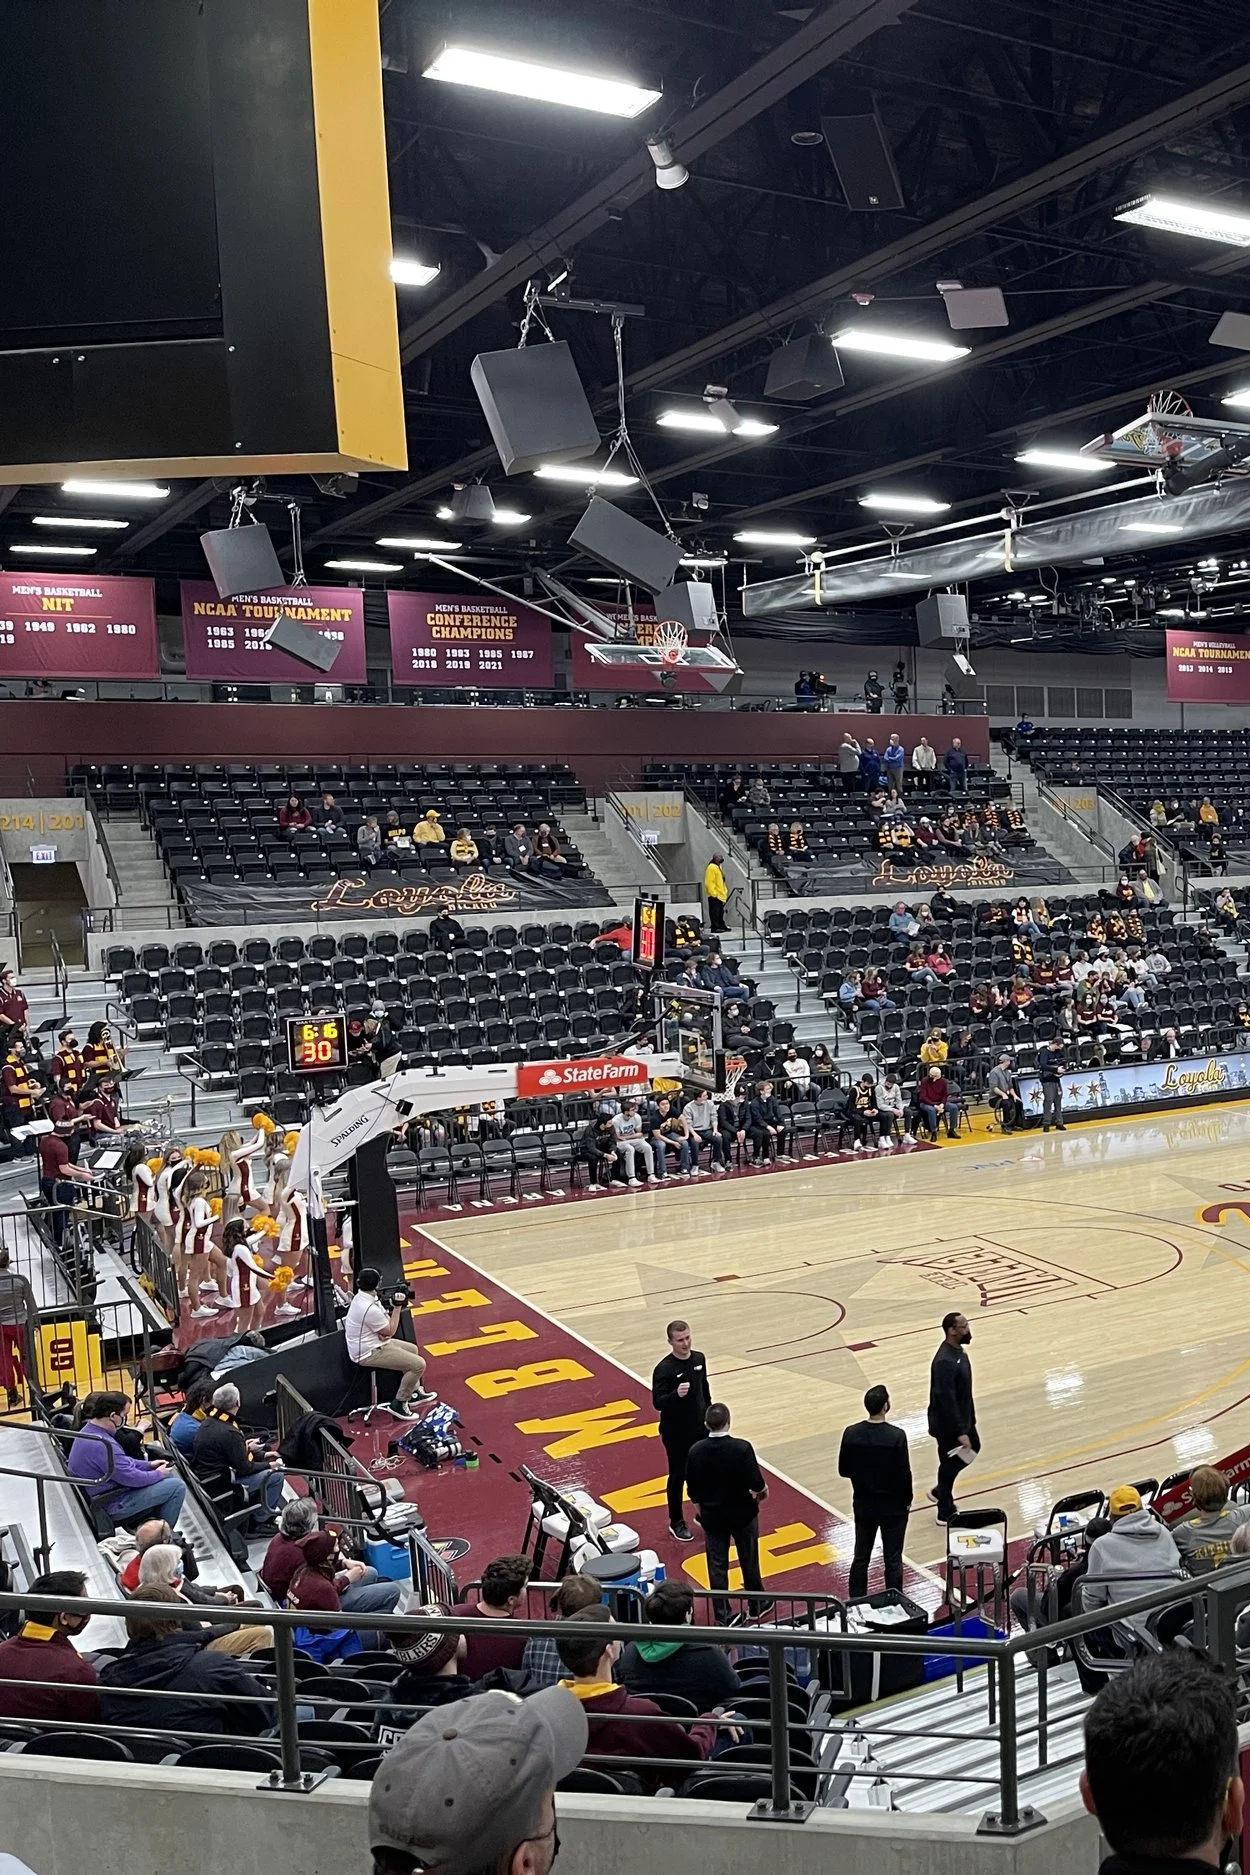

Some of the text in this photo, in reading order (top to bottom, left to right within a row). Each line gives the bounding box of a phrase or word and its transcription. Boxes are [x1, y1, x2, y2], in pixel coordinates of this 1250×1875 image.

[12, 585, 103, 598] MEN'S BASKETBALL
[41, 597, 75, 611] NIT
[260, 595, 313, 606] BASKETBALL
[193, 602, 238, 617] NCAA
[435, 604, 508, 614] MEN'S BASKETBALL
[426, 613, 518, 628] CONFERENCE
[25, 621, 55, 632] 1949
[66, 622, 97, 633] 1962
[106, 624, 136, 635] 1980
[206, 626, 234, 637] 1963
[431, 626, 514, 640] CHAMPIONS
[207, 639, 235, 649] 1985
[1208, 641, 1236, 649] VOLLEYBALL
[411, 648, 534, 659] 1980 1983 1985 1987
[1172, 647, 1196, 657] NCAA
[412, 660, 503, 670] 2018 2019 2021
[1178, 664, 1194, 672] 2013
[1198, 665, 1214, 673] 2014
[653, 803, 681, 818] 202
[0, 815, 85, 831] 214 201
[36, 851, 52, 861] EXIT
[872, 855, 1014, 888] Loyola
[311, 873, 518, 915] Loyola
[303, 1040, 332, 1062] 30
[1162, 1058, 1226, 1096] Loyola
[330, 1114, 369, 1148] SPALDING
[442, 1188, 567, 1212] ARENA
